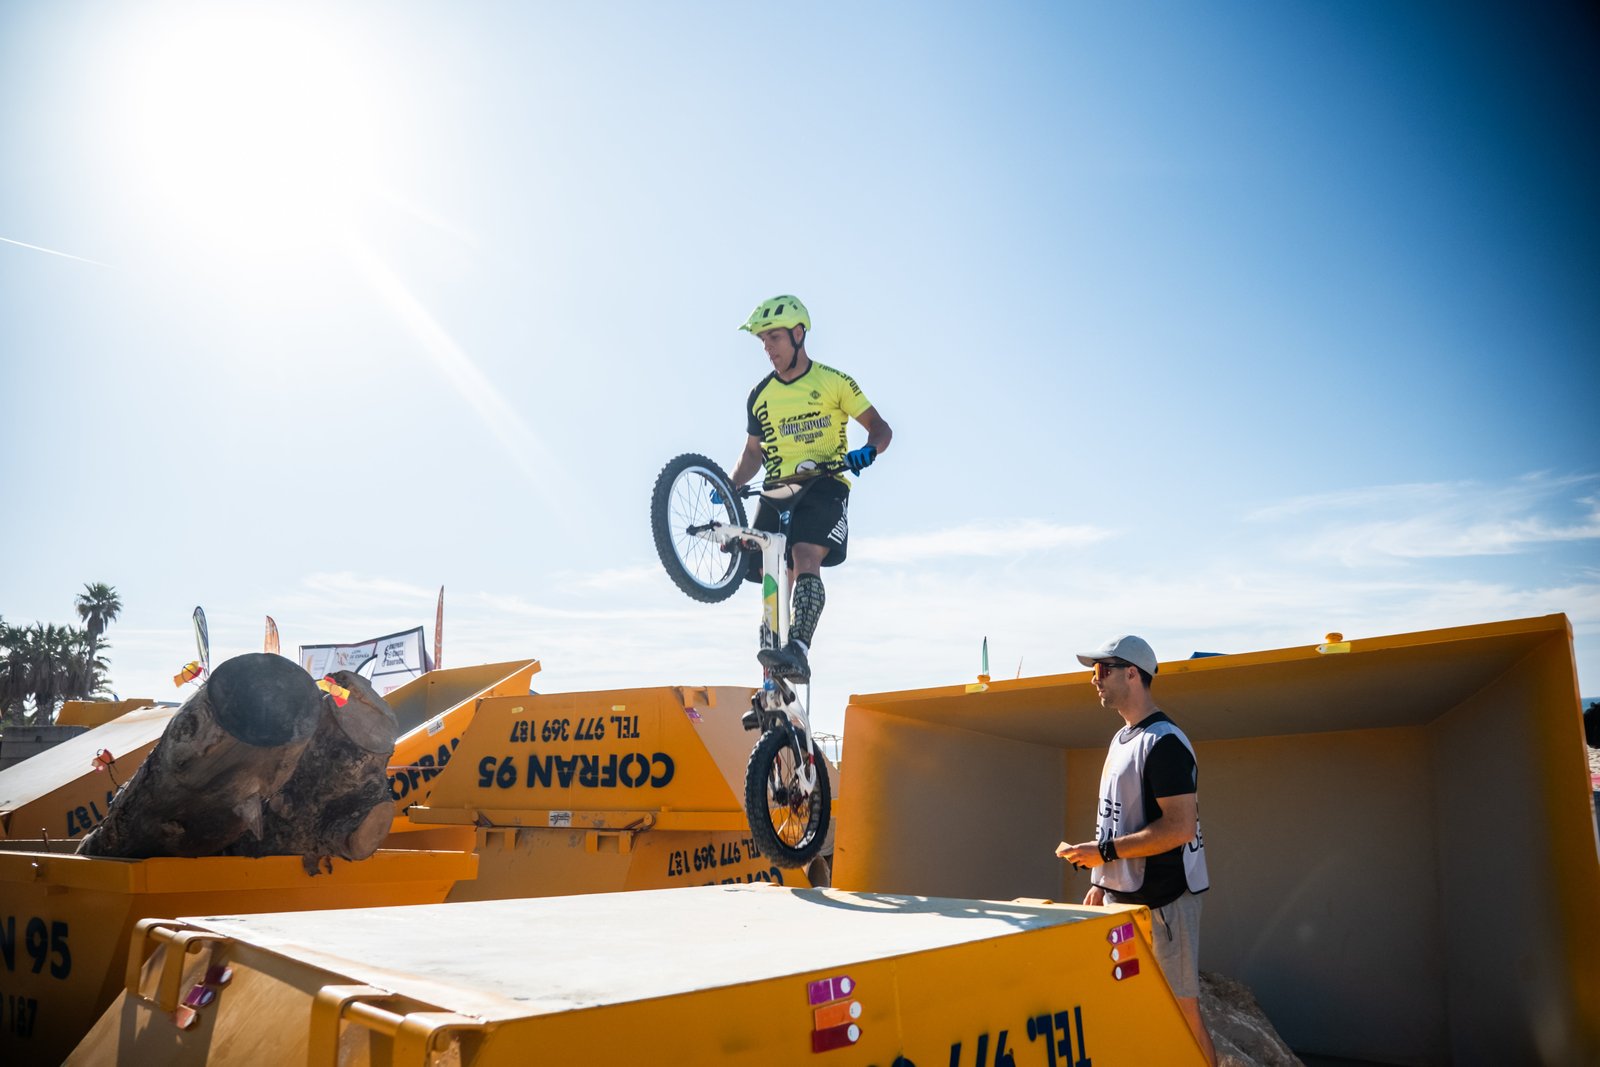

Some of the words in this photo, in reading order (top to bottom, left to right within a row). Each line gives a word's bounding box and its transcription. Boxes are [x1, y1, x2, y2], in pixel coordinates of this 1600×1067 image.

[509, 720, 536, 743] 187
[541, 718, 570, 743] 369
[574, 717, 605, 741] 977
[610, 715, 640, 739] TEL.
[478, 755, 517, 789] 95
[527, 752, 675, 789] COFRAN
[668, 850, 690, 877] 187
[693, 843, 717, 872] 369
[720, 842, 741, 866] 977
[25, 915, 72, 980] 95
[9, 996, 38, 1038] 187
